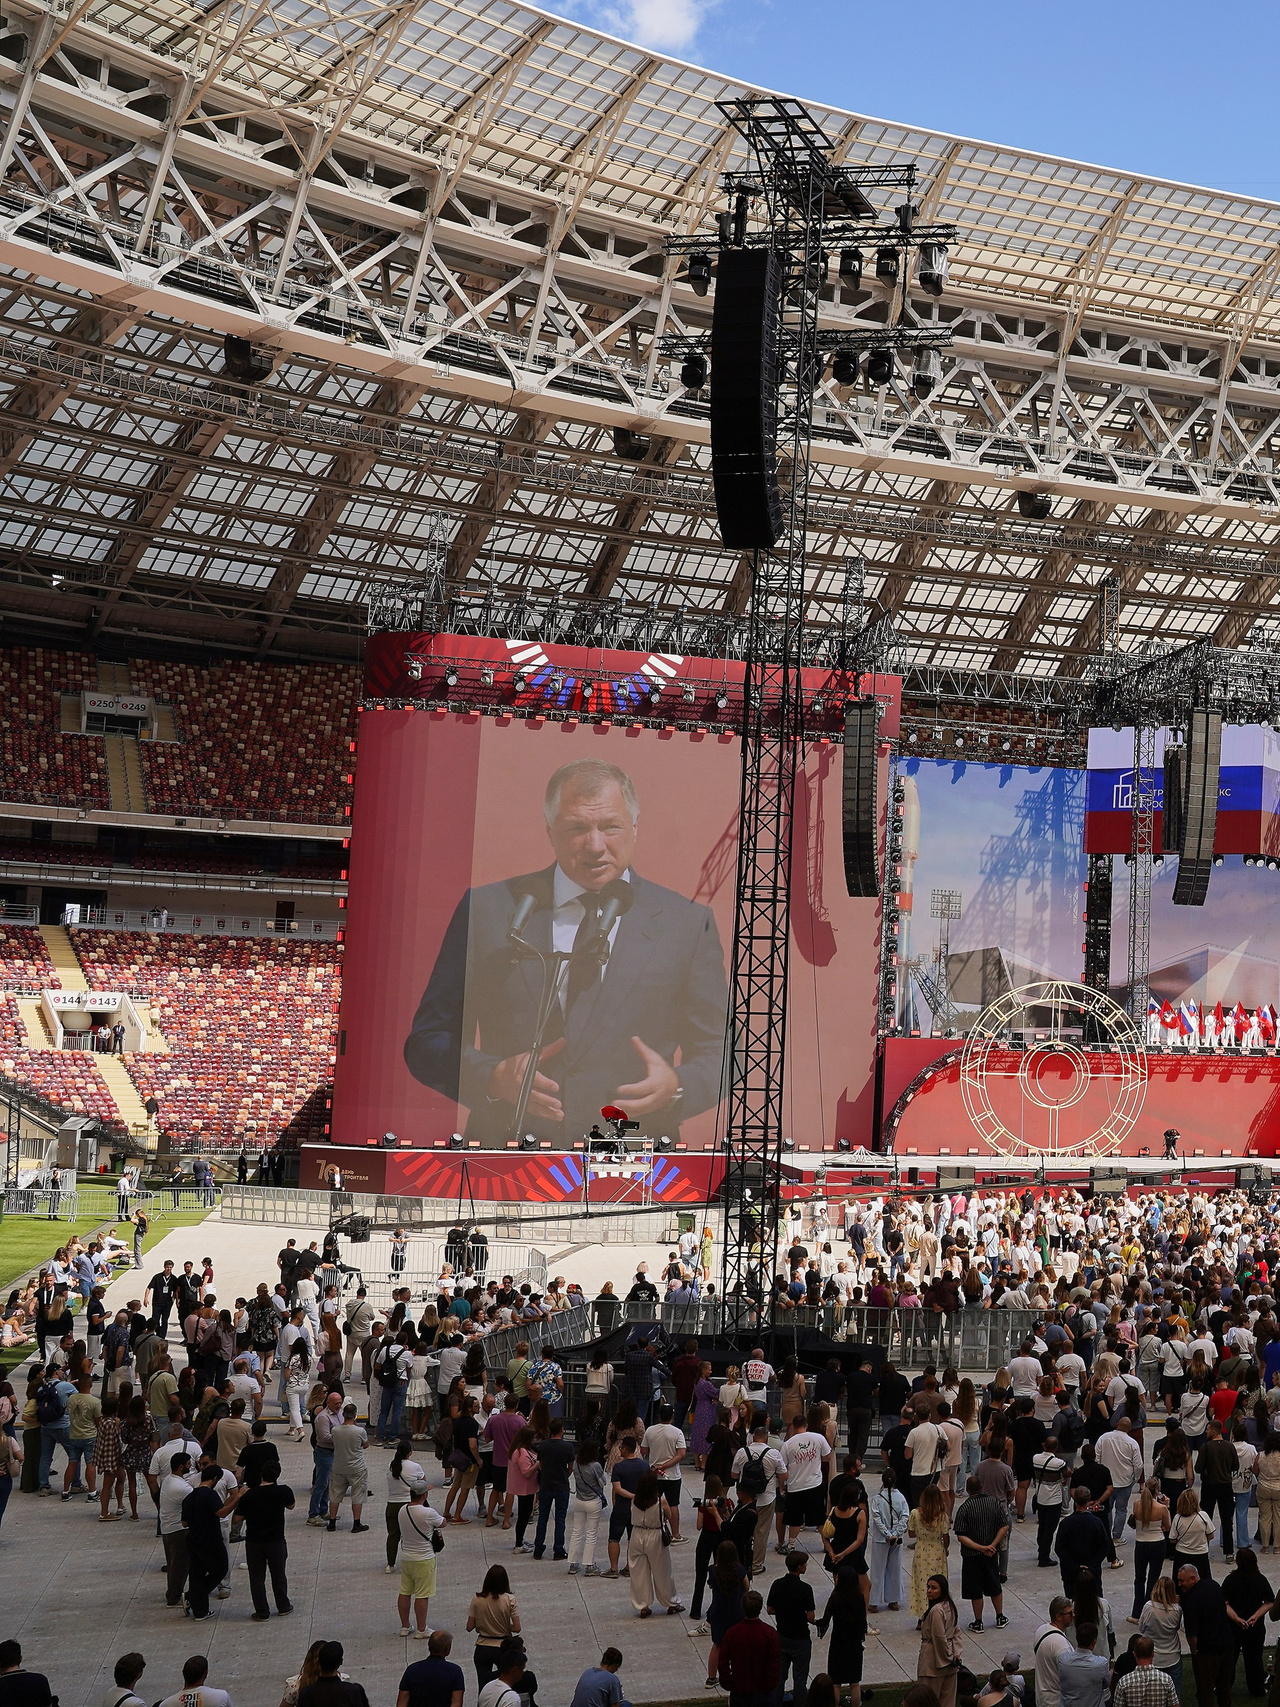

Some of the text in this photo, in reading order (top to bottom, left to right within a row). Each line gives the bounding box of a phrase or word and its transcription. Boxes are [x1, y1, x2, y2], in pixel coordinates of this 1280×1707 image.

[96, 699, 115, 709] 250
[128, 702, 146, 712] 249
[61, 996, 81, 1005] 144
[98, 997, 117, 1006] 143
